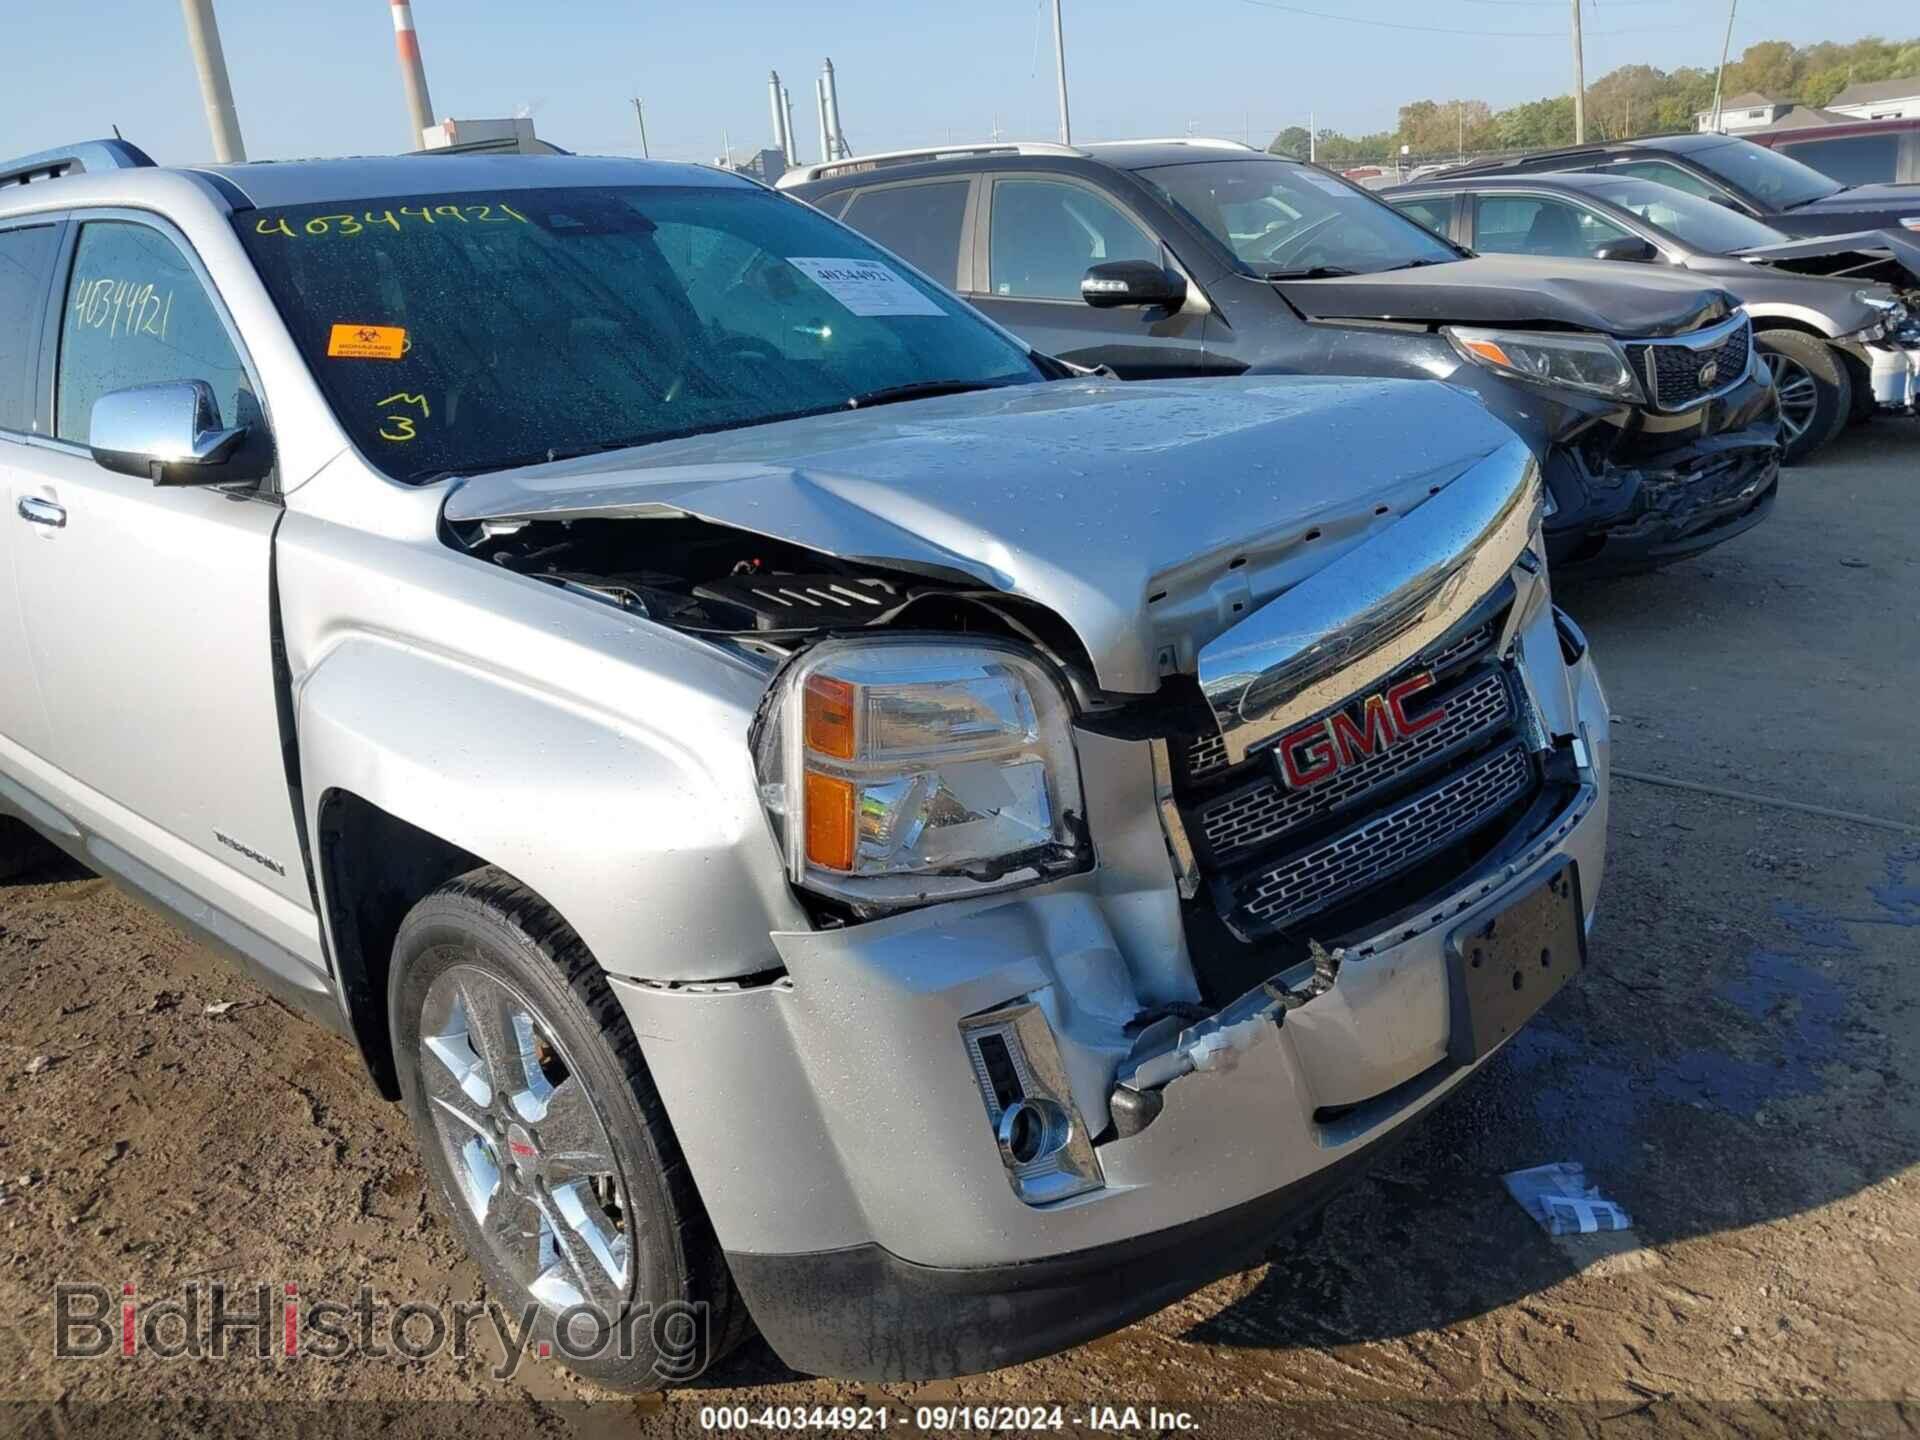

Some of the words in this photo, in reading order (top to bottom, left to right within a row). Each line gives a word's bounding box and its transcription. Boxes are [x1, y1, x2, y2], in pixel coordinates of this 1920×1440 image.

[255, 204, 528, 237] 40344921
[75, 278, 174, 342] 40344921
[379, 415, 416, 441] 3
[1275, 670, 1447, 790] GMC
